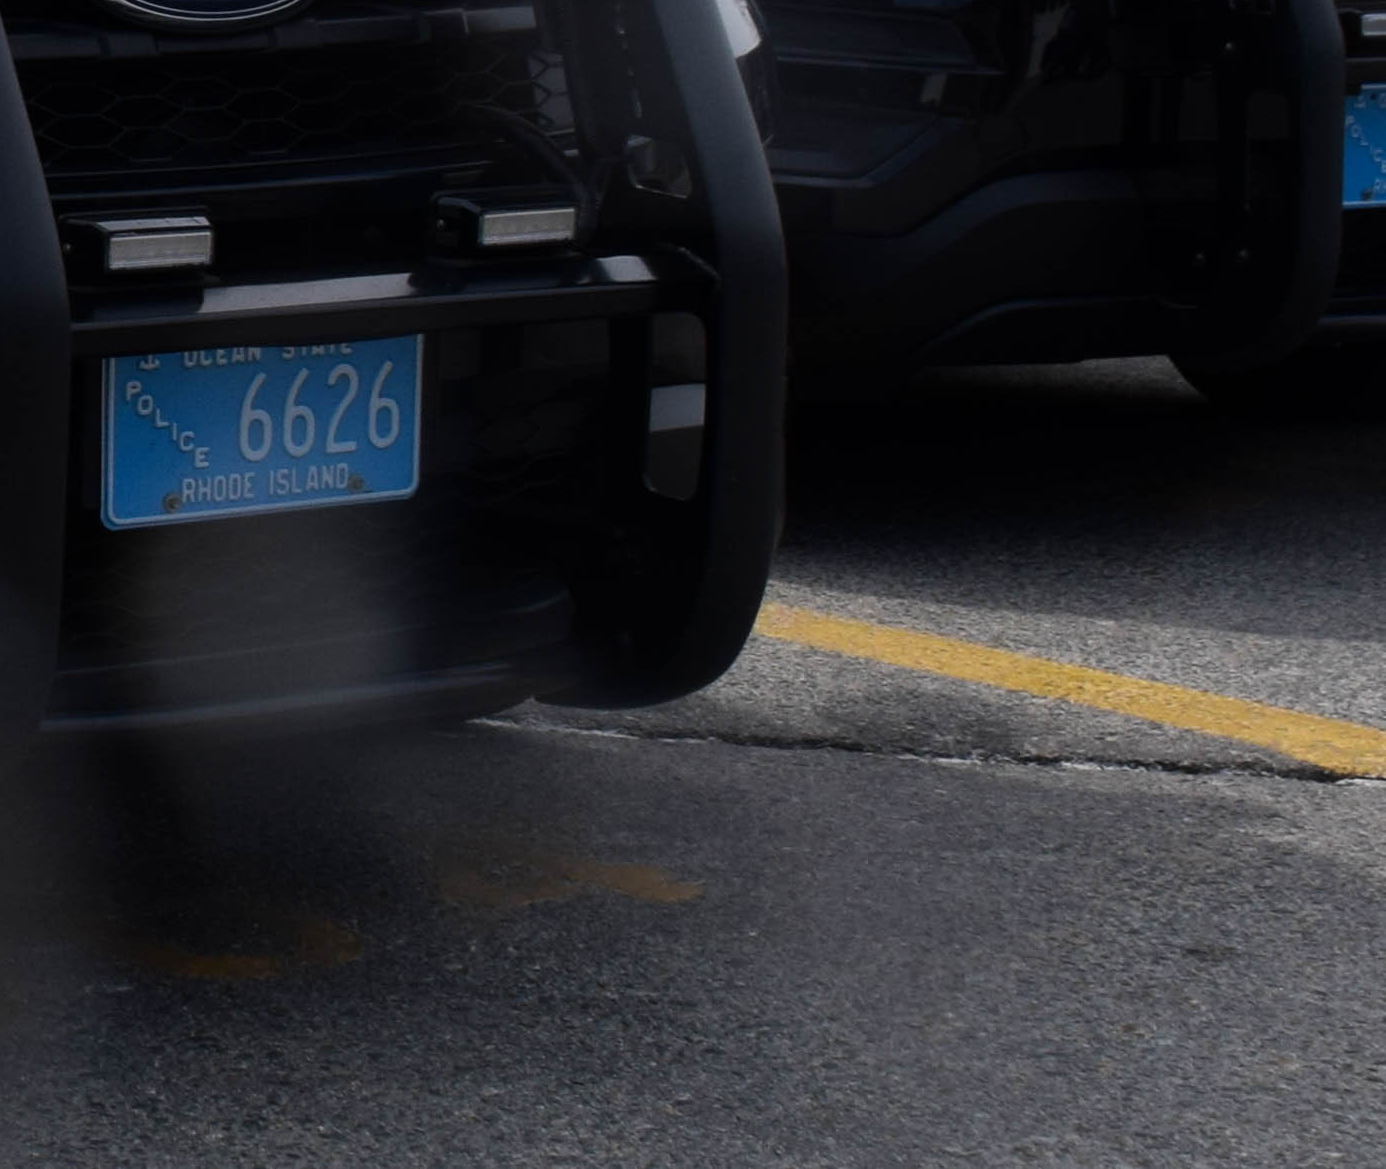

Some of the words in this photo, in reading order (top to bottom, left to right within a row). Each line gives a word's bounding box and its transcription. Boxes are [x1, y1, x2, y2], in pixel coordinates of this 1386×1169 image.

[125, 380, 211, 469] POLICE
[239, 360, 401, 462] 6626
[181, 471, 256, 504] RHODE
[269, 462, 349, 496] ISLAND
